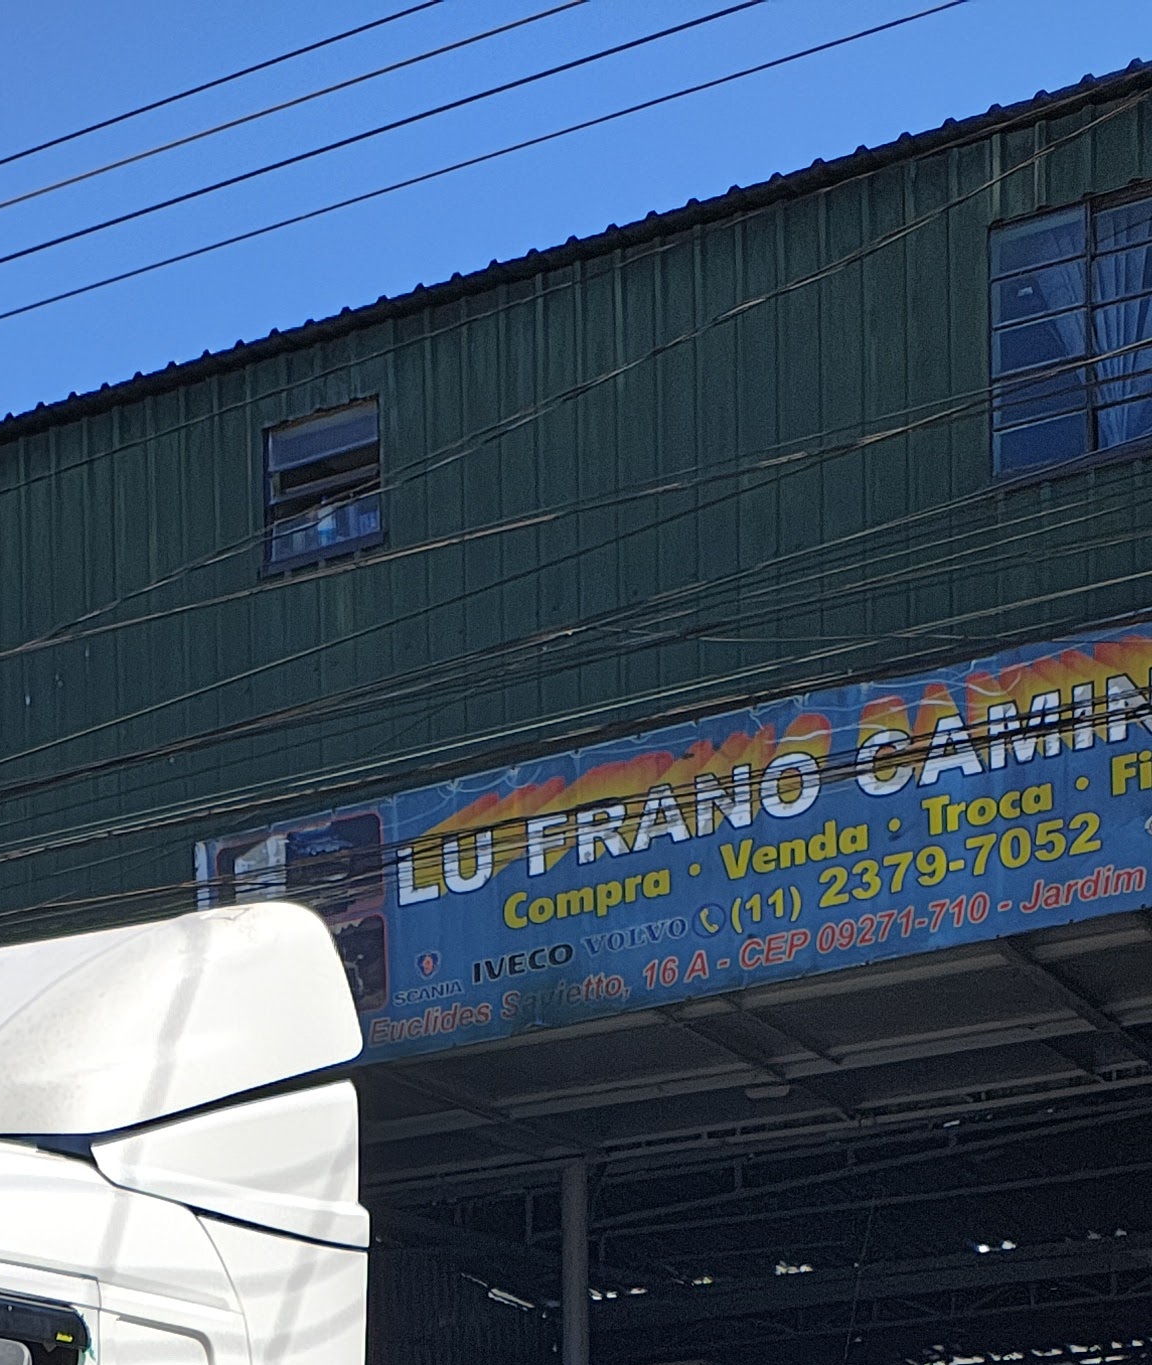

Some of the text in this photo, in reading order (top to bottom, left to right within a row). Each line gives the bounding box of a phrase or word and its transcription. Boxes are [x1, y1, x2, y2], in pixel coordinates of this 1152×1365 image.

[396, 827, 495, 907] LU
[526, 751, 822, 878] FRANO
[503, 868, 671, 930] Compra
[720, 819, 869, 882] Venda
[921, 783, 1054, 836] Troca
[731, 812, 1102, 933] (11) 2379-7052
[370, 1004, 491, 1046] Euclides
[643, 956, 678, 990] 16
[684, 950, 709, 982] A
[739, 930, 810, 971] CEP
[818, 893, 990, 954] 09271-710
[1021, 864, 1147, 914] Jardim
[393, 980, 463, 1006] SCANIA
[472, 943, 574, 984] IVECO
[583, 917, 688, 955] VOLVO
